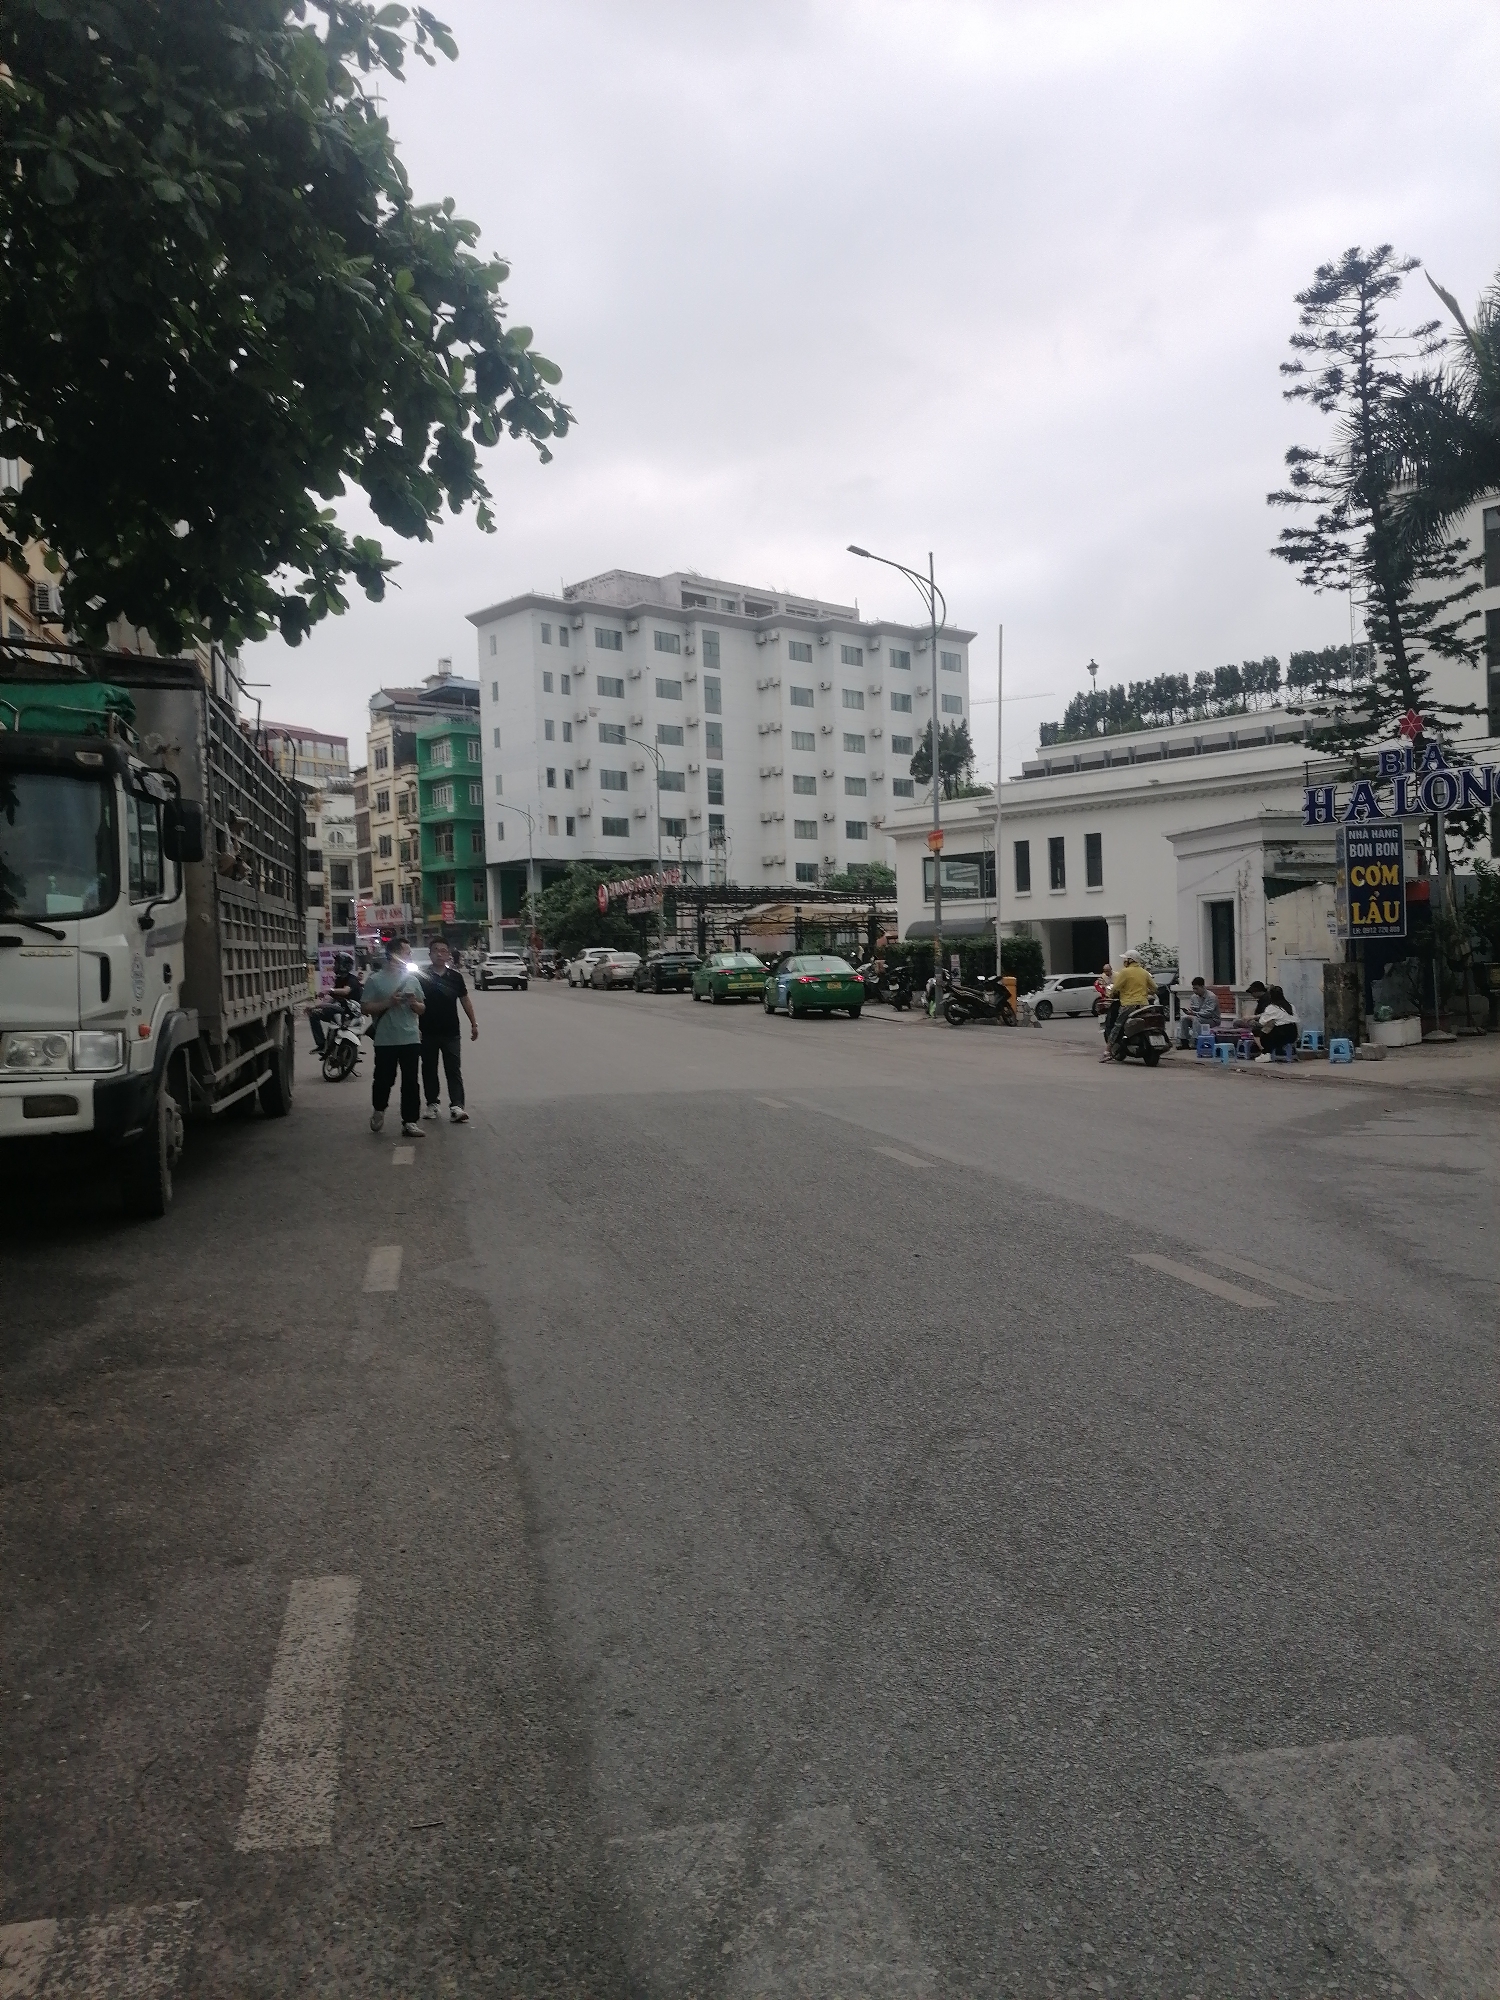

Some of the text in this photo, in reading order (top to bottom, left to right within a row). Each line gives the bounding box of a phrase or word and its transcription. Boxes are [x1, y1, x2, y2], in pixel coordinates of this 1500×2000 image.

[1377, 743, 1450, 777] BIA
[1391, 764, 1500, 818] LON
[1348, 828, 1369, 840] NHÀ
[1350, 842, 1399, 857] BON BON
[1351, 861, 1399, 887] CƠM
[1351, 891, 1400, 924] LẨU
